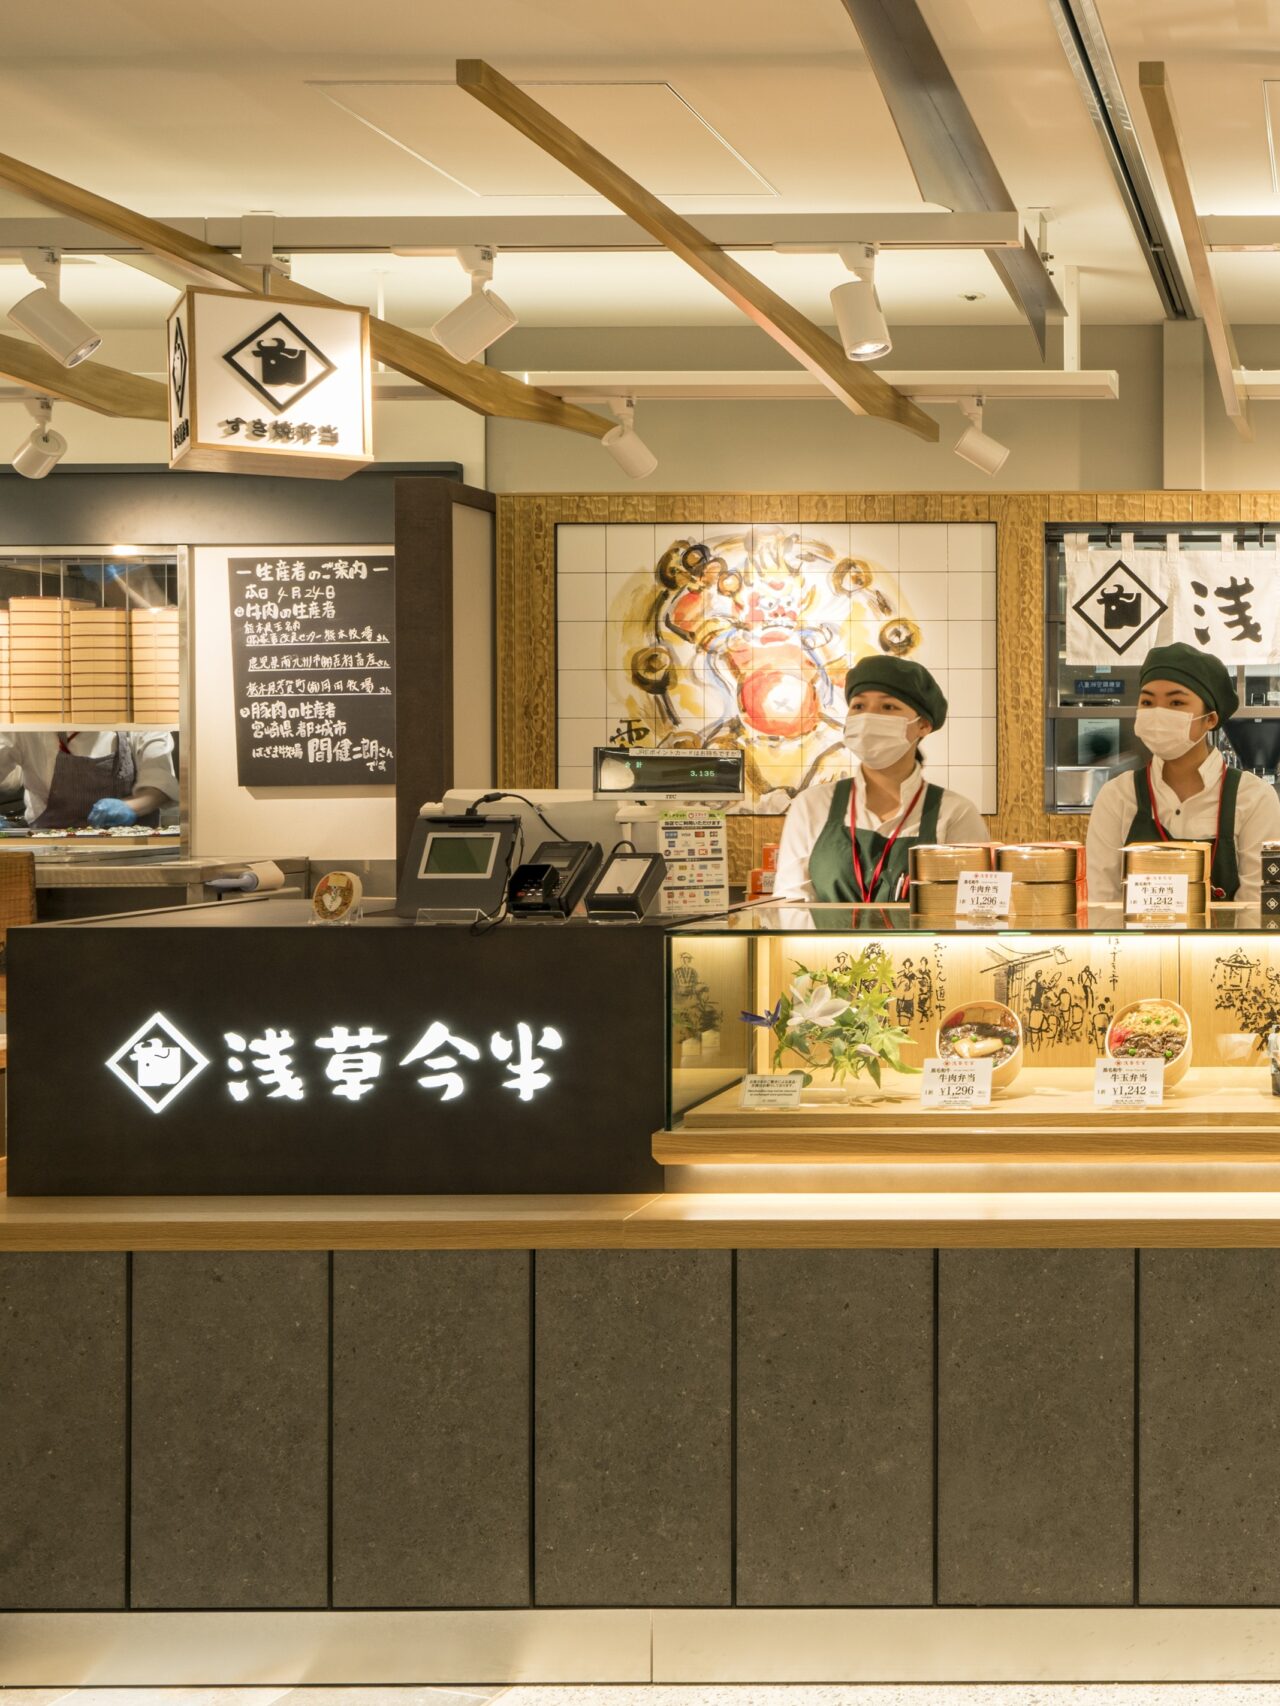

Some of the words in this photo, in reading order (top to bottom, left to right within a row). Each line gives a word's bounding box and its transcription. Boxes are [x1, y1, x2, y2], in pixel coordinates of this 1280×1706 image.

[224, 417, 339, 447] すき焼弁当
[245, 601, 336, 620] 牛肉の生産者
[251, 700, 337, 719] 豚肉の生産者
[224, 1021, 564, 1102] 浅草今半
[939, 1073, 976, 1083] 牛肉弁当
[940, 1086, 974, 1096] ¥1,296
[1112, 1086, 1147, 1095] ¥1,242
